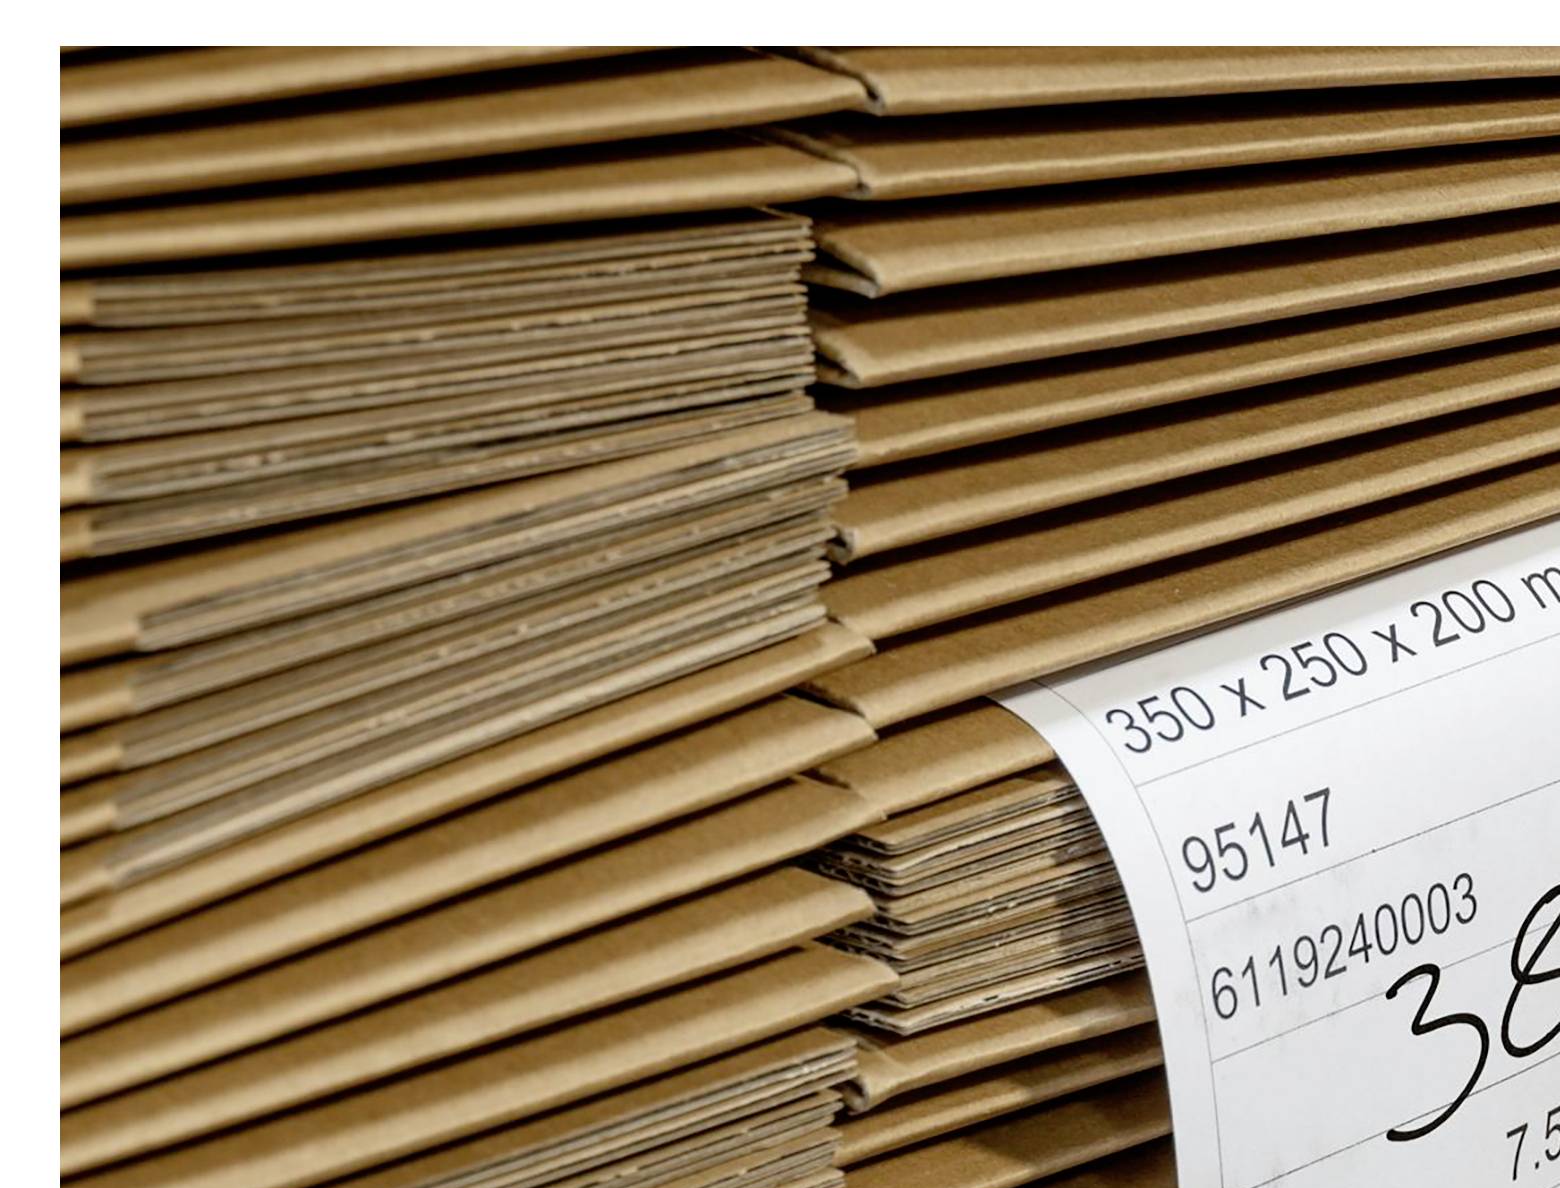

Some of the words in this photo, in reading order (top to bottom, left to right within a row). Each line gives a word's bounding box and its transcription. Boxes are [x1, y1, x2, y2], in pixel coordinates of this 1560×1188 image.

[1105, 685, 1216, 754] 350
[1219, 676, 1268, 718] x
[1258, 631, 1368, 702] 250
[1371, 622, 1418, 664] x
[1409, 578, 1516, 648] 200
[1181, 786, 1332, 894] 95147
[1210, 872, 1480, 1021] 6119240003
